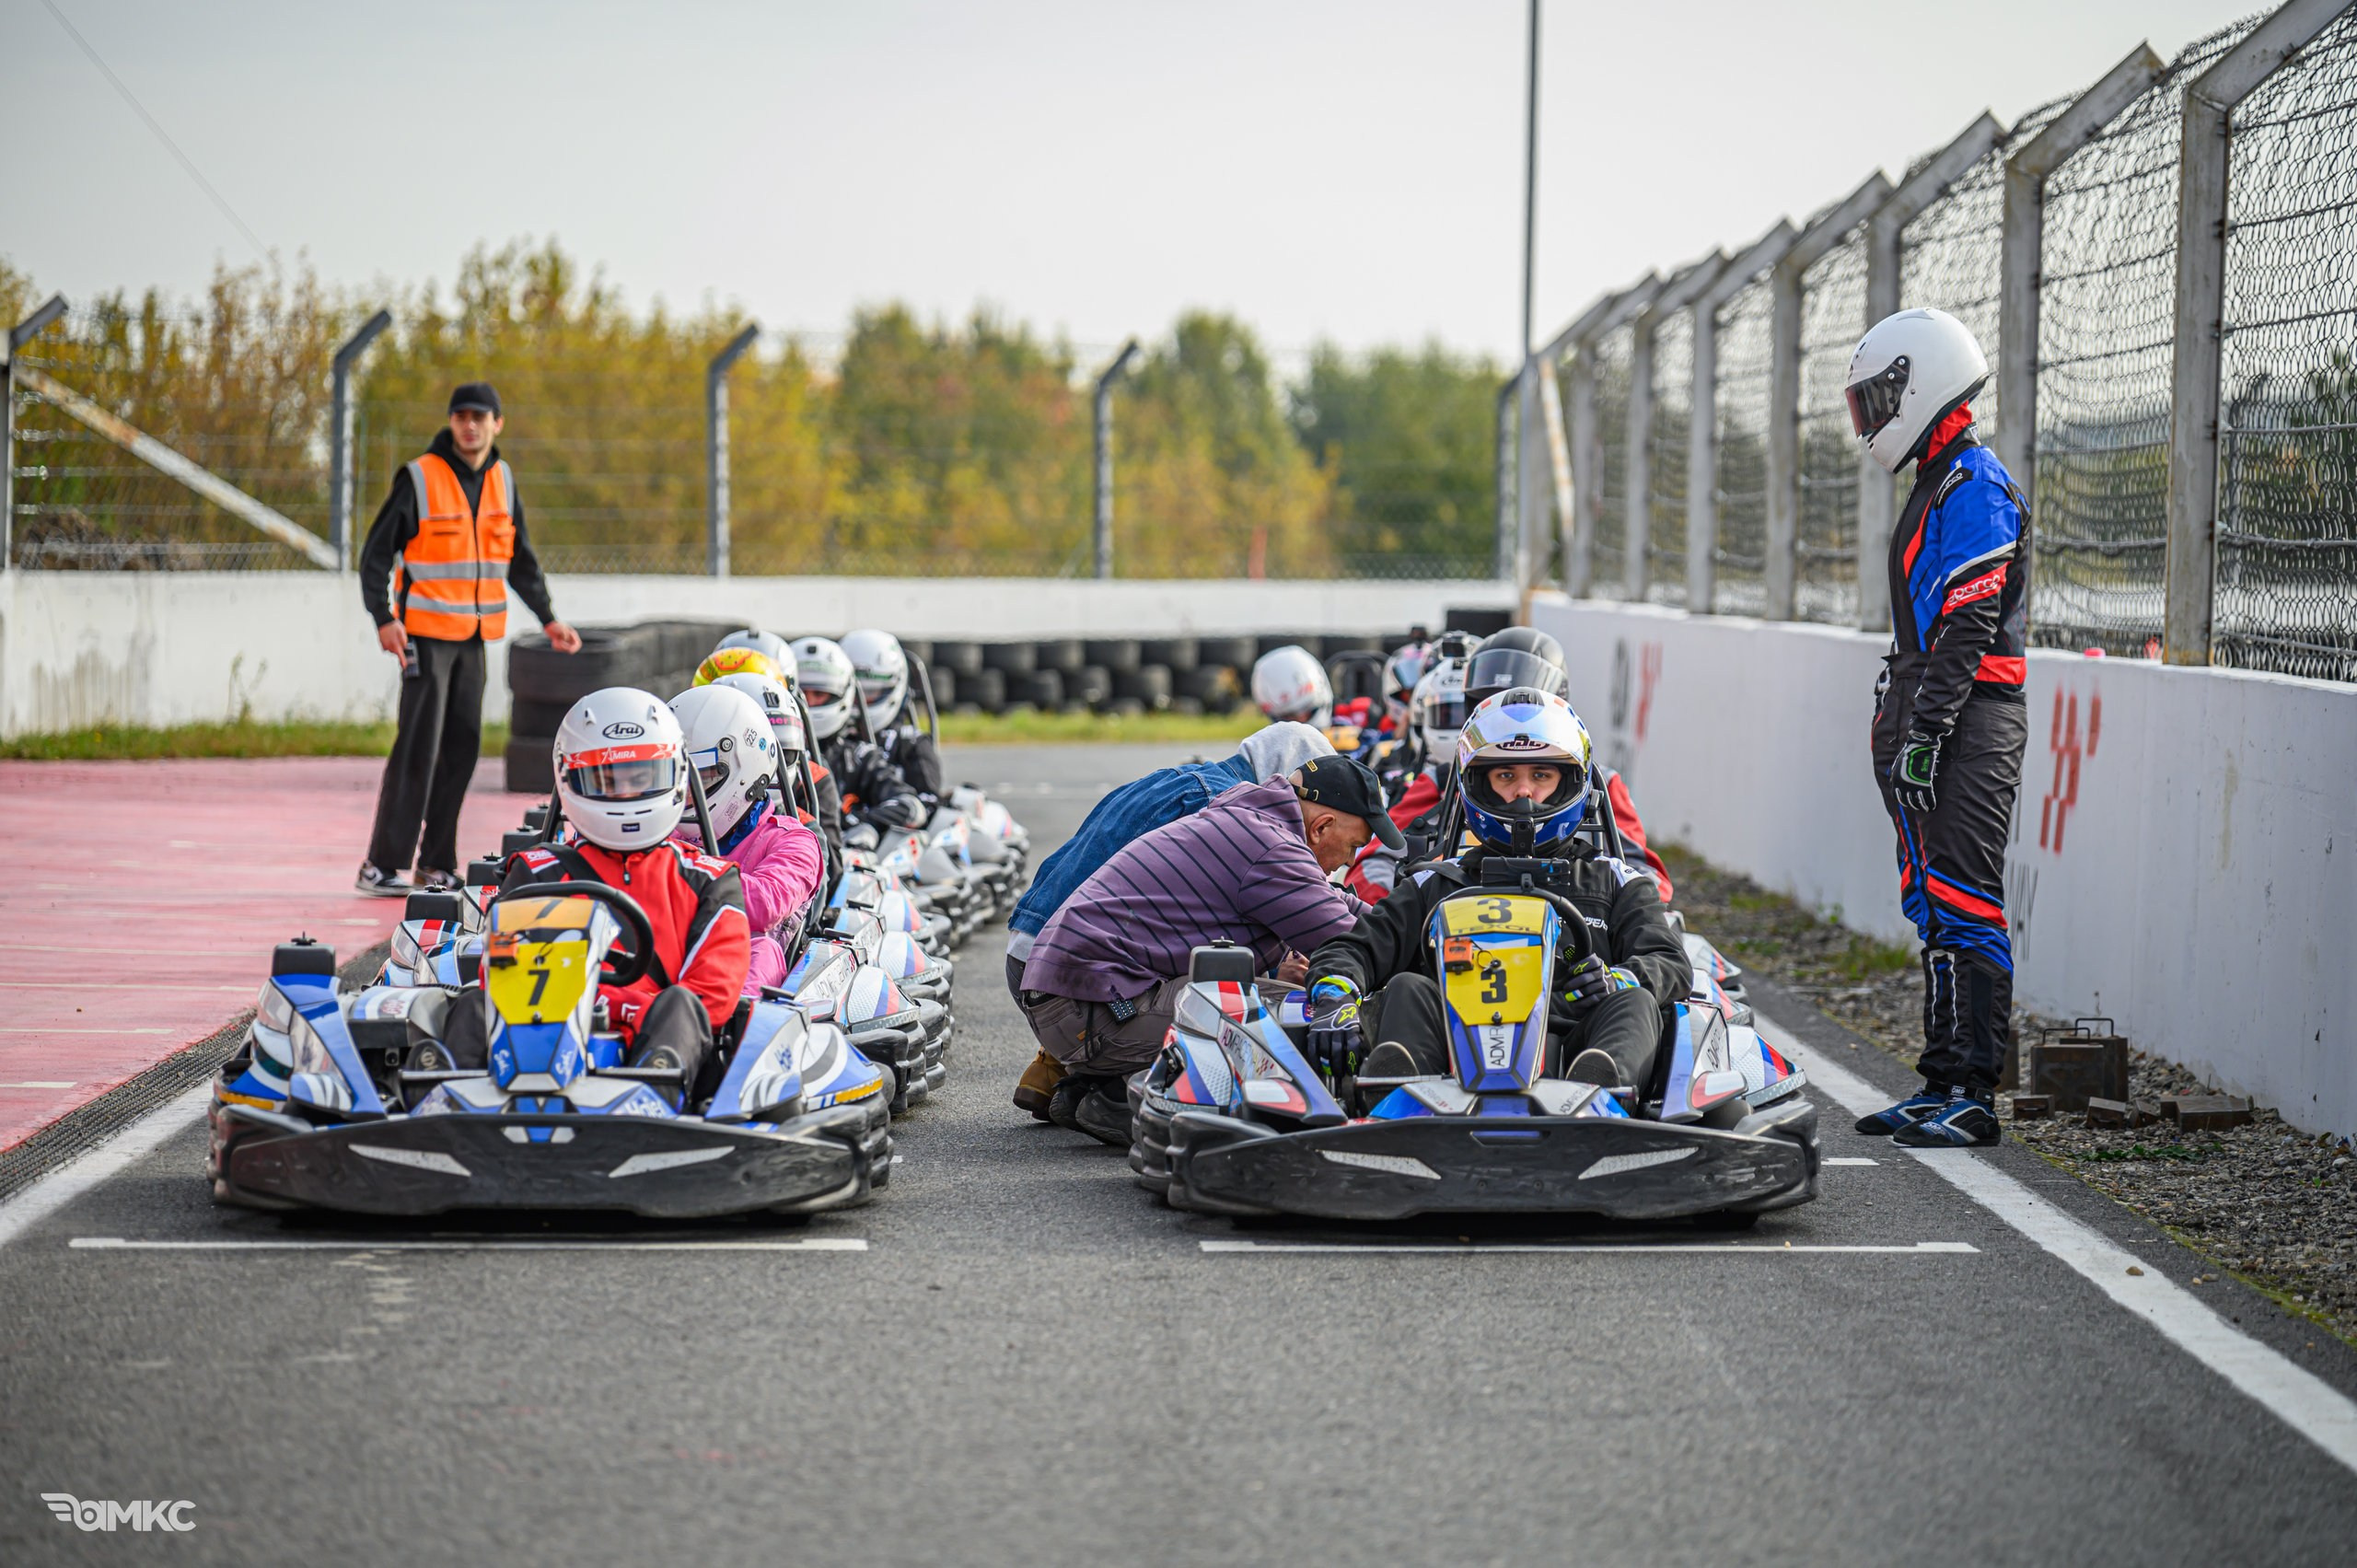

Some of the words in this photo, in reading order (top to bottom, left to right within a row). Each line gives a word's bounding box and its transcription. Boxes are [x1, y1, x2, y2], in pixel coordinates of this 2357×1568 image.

[605, 724, 640, 736] Arai
[530, 899, 563, 919] 7
[1477, 898, 1512, 923] 3
[528, 970, 550, 1005] 7
[1480, 969, 1507, 1004] 3
[1951, 1086, 1966, 1095] OMP
